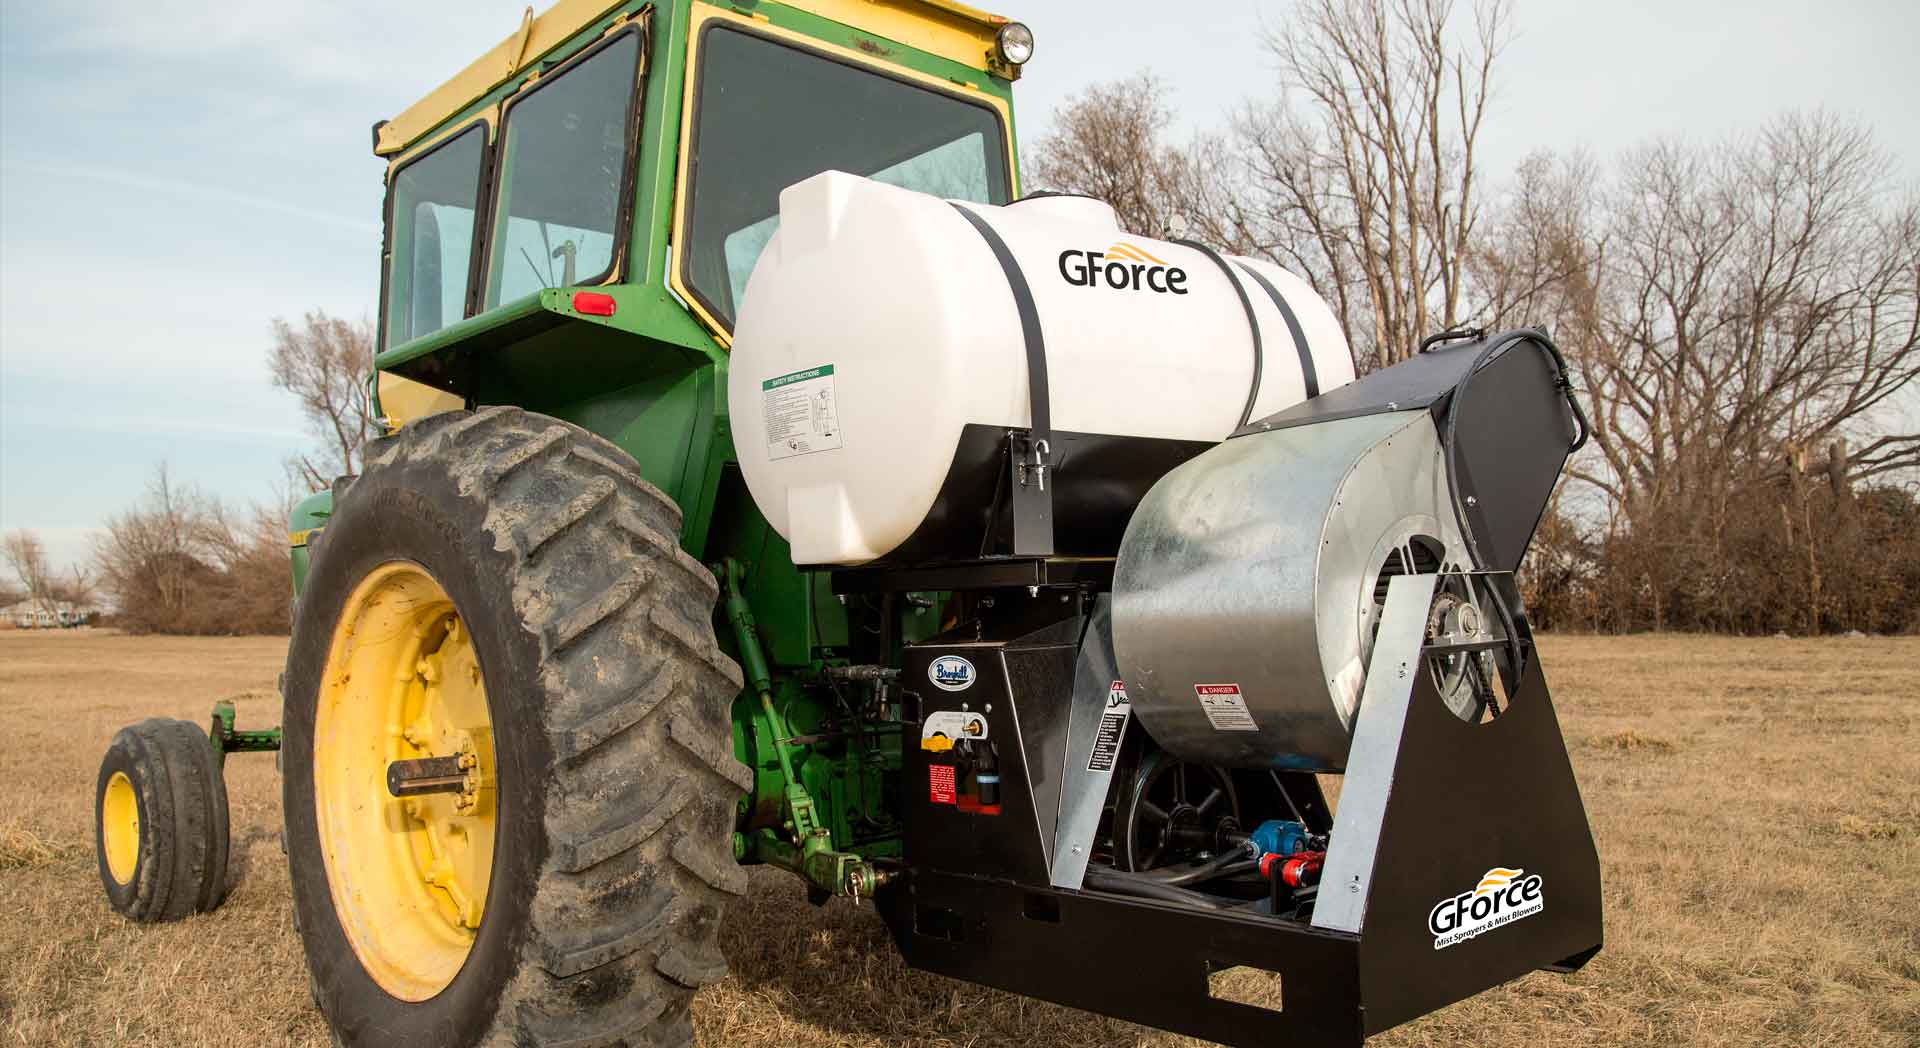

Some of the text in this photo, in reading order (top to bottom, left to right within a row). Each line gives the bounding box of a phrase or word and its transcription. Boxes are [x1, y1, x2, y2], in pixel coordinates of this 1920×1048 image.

[1059, 249, 1189, 295] GForce
[1430, 877, 1541, 934] GForce
[1436, 903, 1542, 948] Mist Sprayers & Mist Blowers
